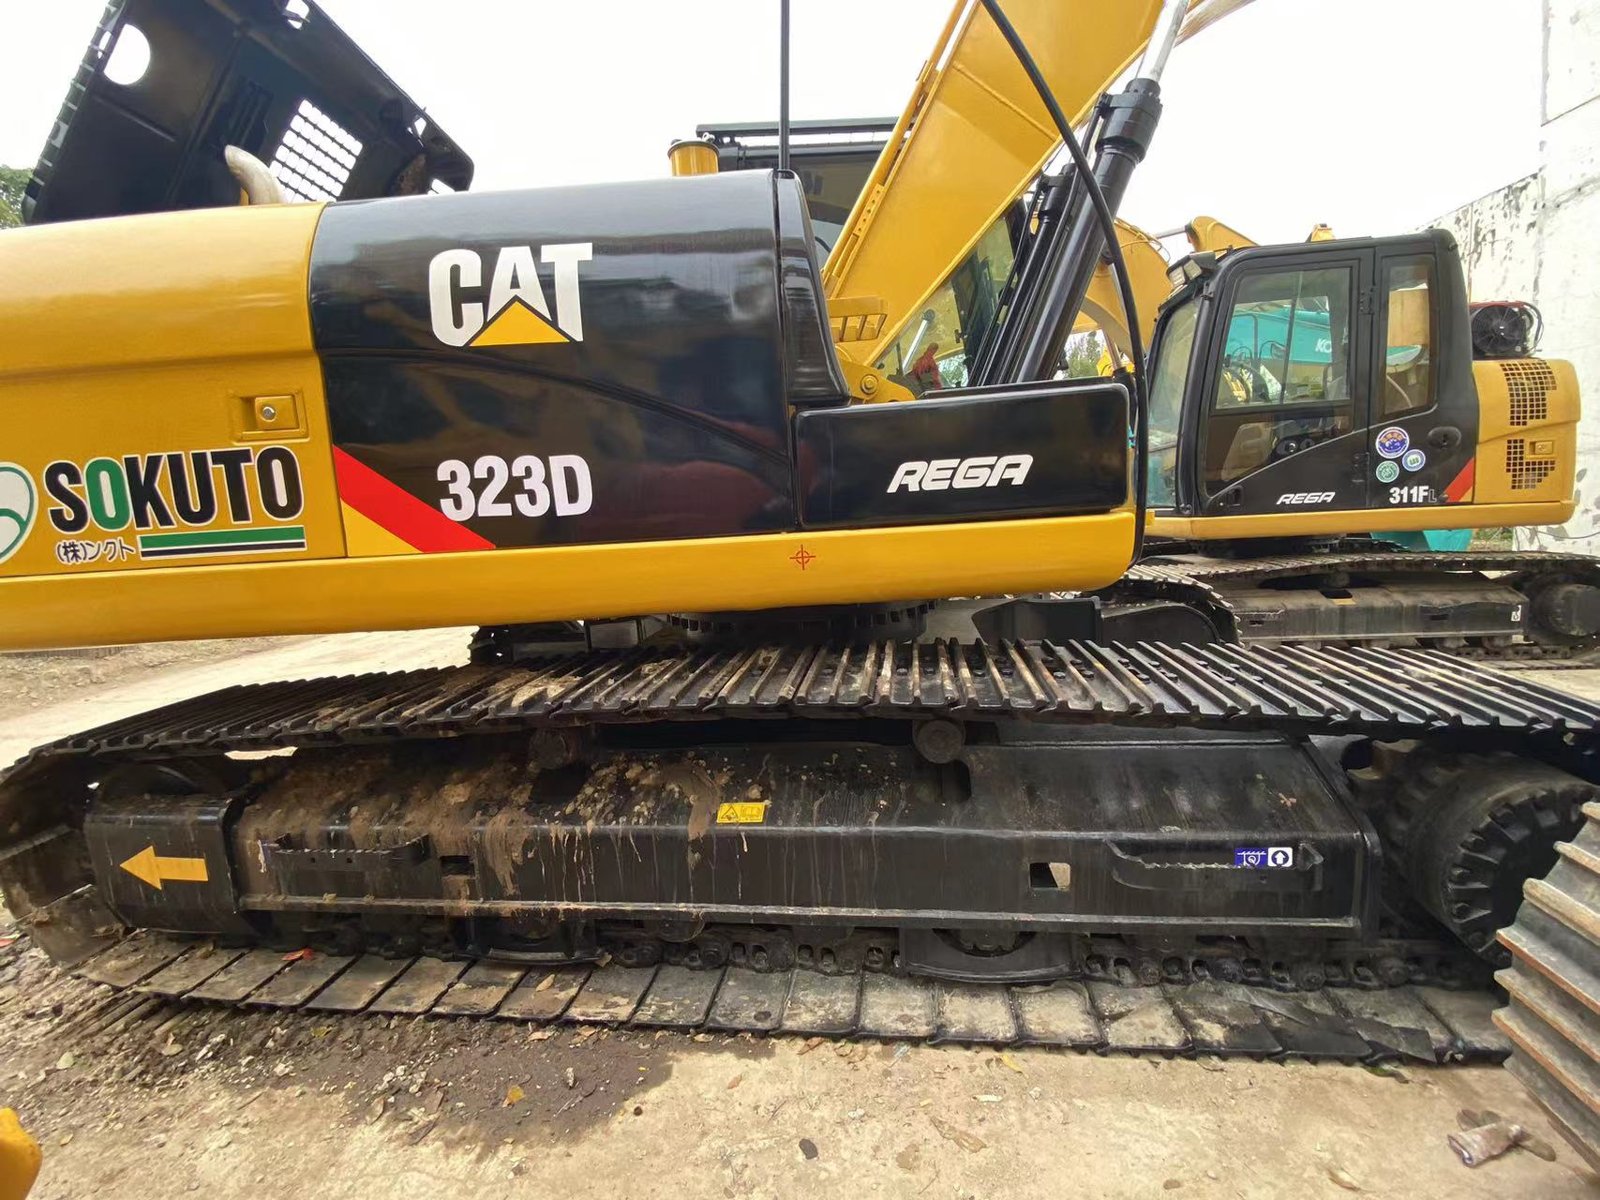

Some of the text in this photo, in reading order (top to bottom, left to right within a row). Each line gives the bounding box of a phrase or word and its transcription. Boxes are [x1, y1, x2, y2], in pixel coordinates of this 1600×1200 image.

[428, 242, 593, 347] CAT
[43, 446, 304, 533] SOKUTO
[437, 454, 593, 521] 323D
[886, 453, 1034, 493] REGA
[1276, 491, 1336, 505] REGA
